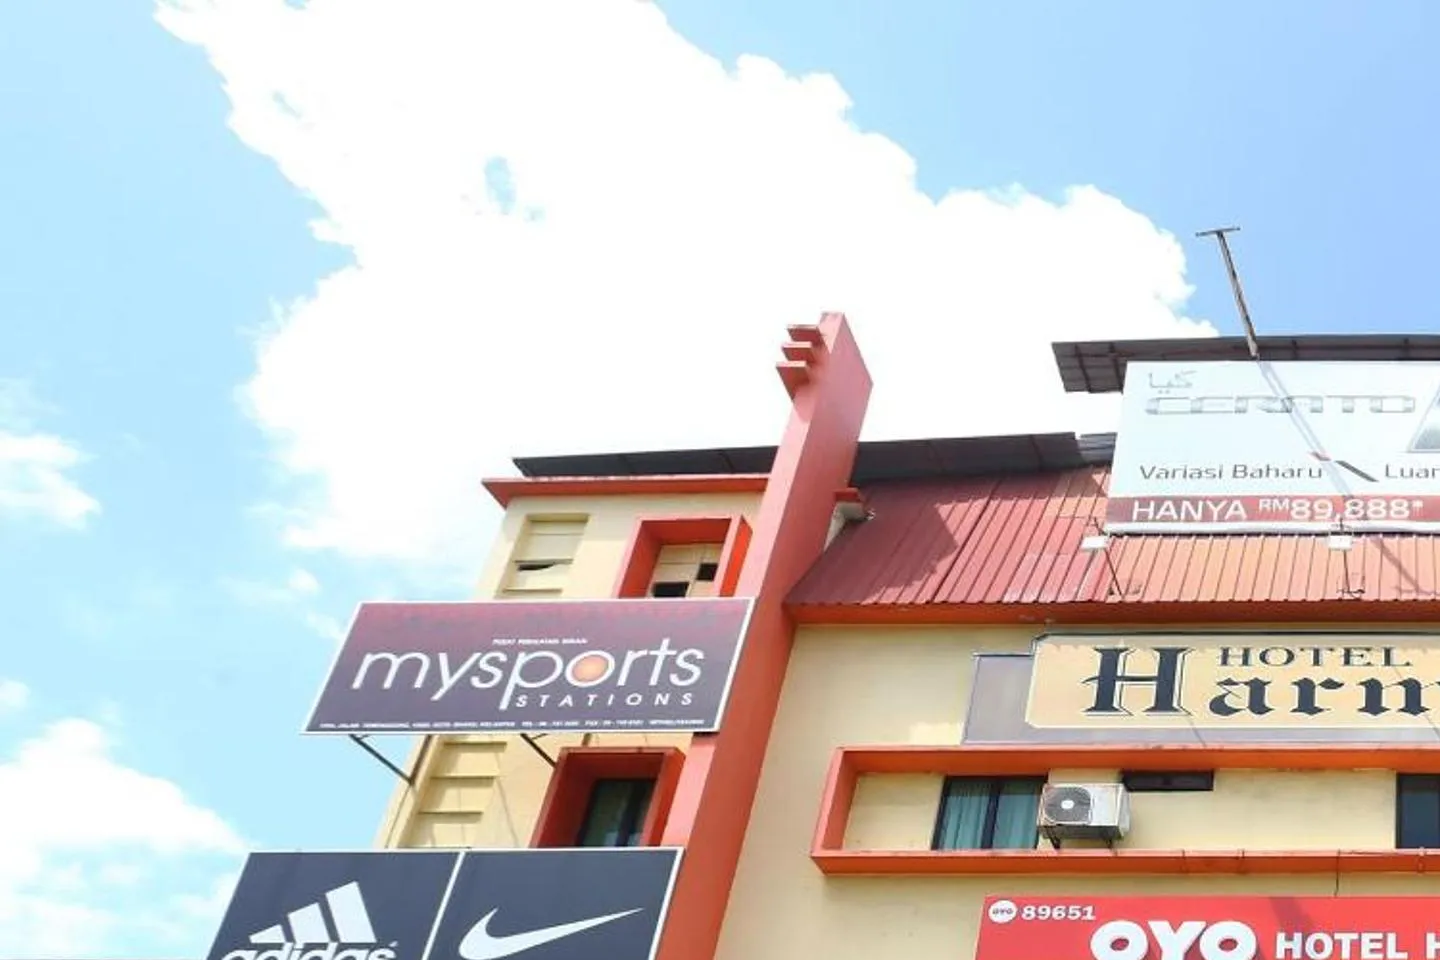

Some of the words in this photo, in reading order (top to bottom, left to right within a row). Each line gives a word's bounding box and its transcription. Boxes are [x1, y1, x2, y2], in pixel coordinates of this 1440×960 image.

[1139, 463, 1224, 480] Variasi
[1231, 463, 1323, 480] Baharu
[1131, 499, 1247, 521] HANYA
[1219, 646, 1412, 668] HOTEL
[351, 637, 705, 711] mysports
[516, 691, 693, 708] STATIONS
[1021, 904, 1097, 920] 89651
[1275, 931, 1408, 960] HOTEL
